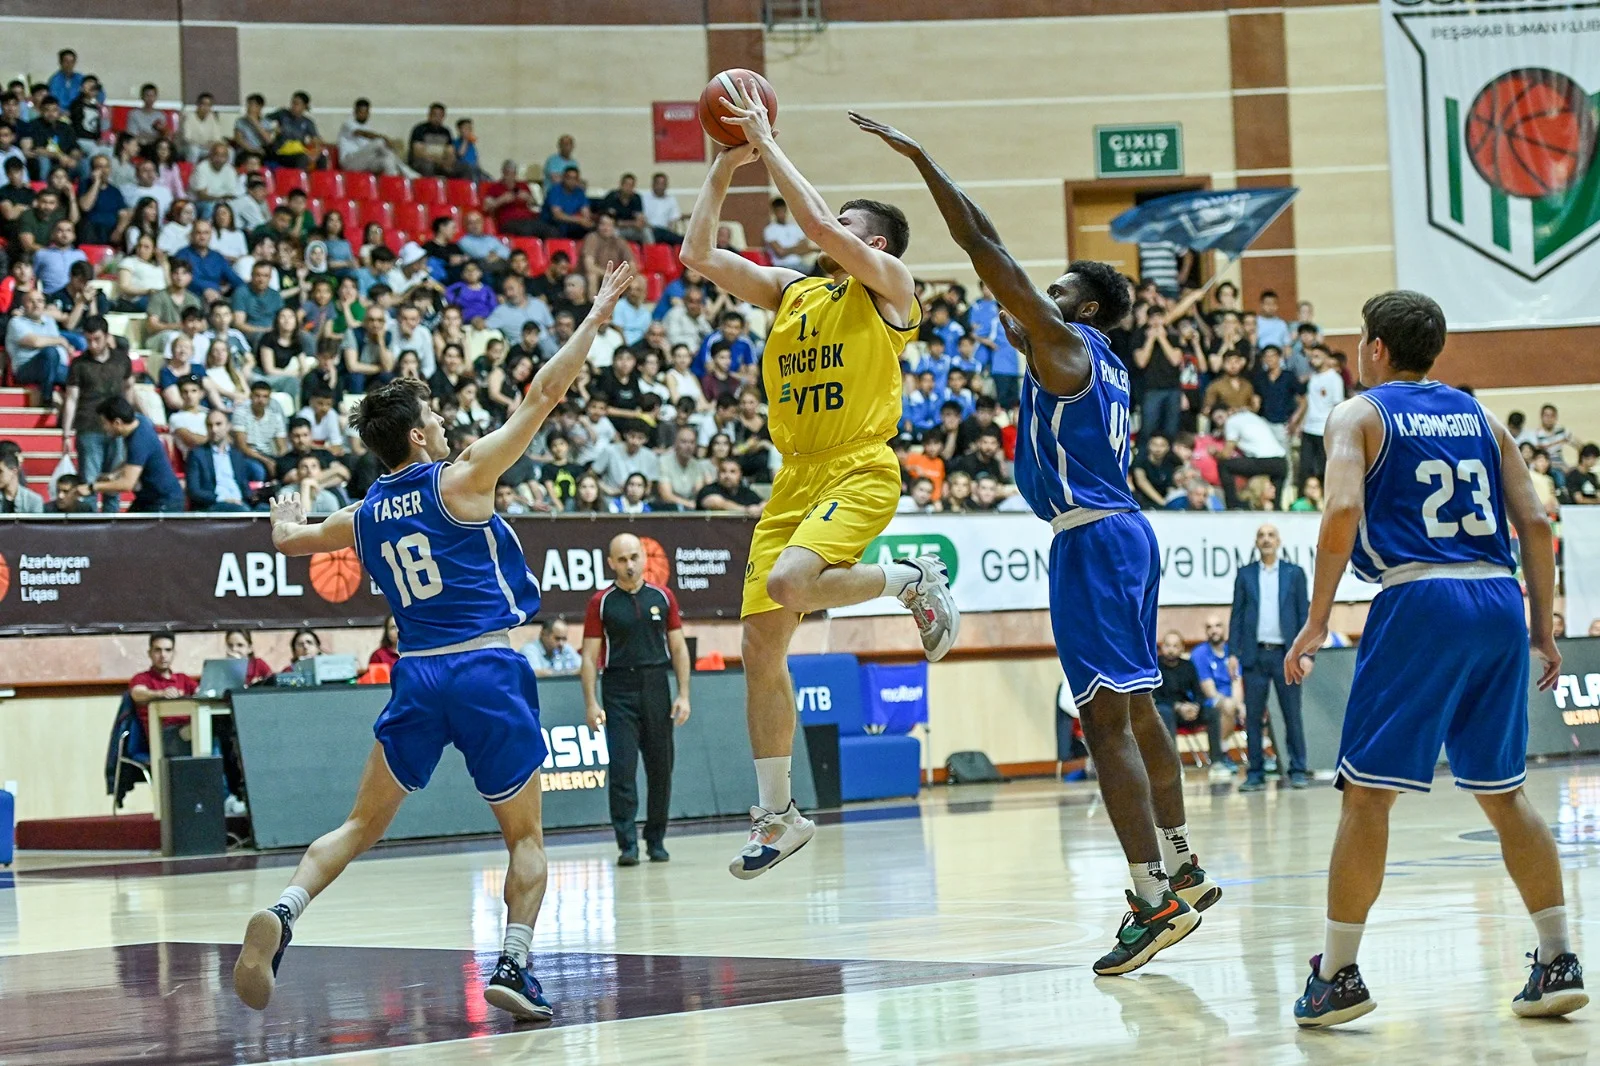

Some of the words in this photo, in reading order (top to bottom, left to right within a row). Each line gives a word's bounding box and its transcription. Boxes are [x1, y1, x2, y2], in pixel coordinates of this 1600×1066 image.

[1114, 150, 1165, 168] EXIT
[821, 343, 844, 369] BK
[1415, 459, 1497, 539] 23
[20, 570, 81, 585] Basketbol
[214, 552, 304, 597] ABL
[381, 532, 443, 608] 18
[541, 549, 615, 592] ABL
[540, 769, 606, 792] ENERGY
